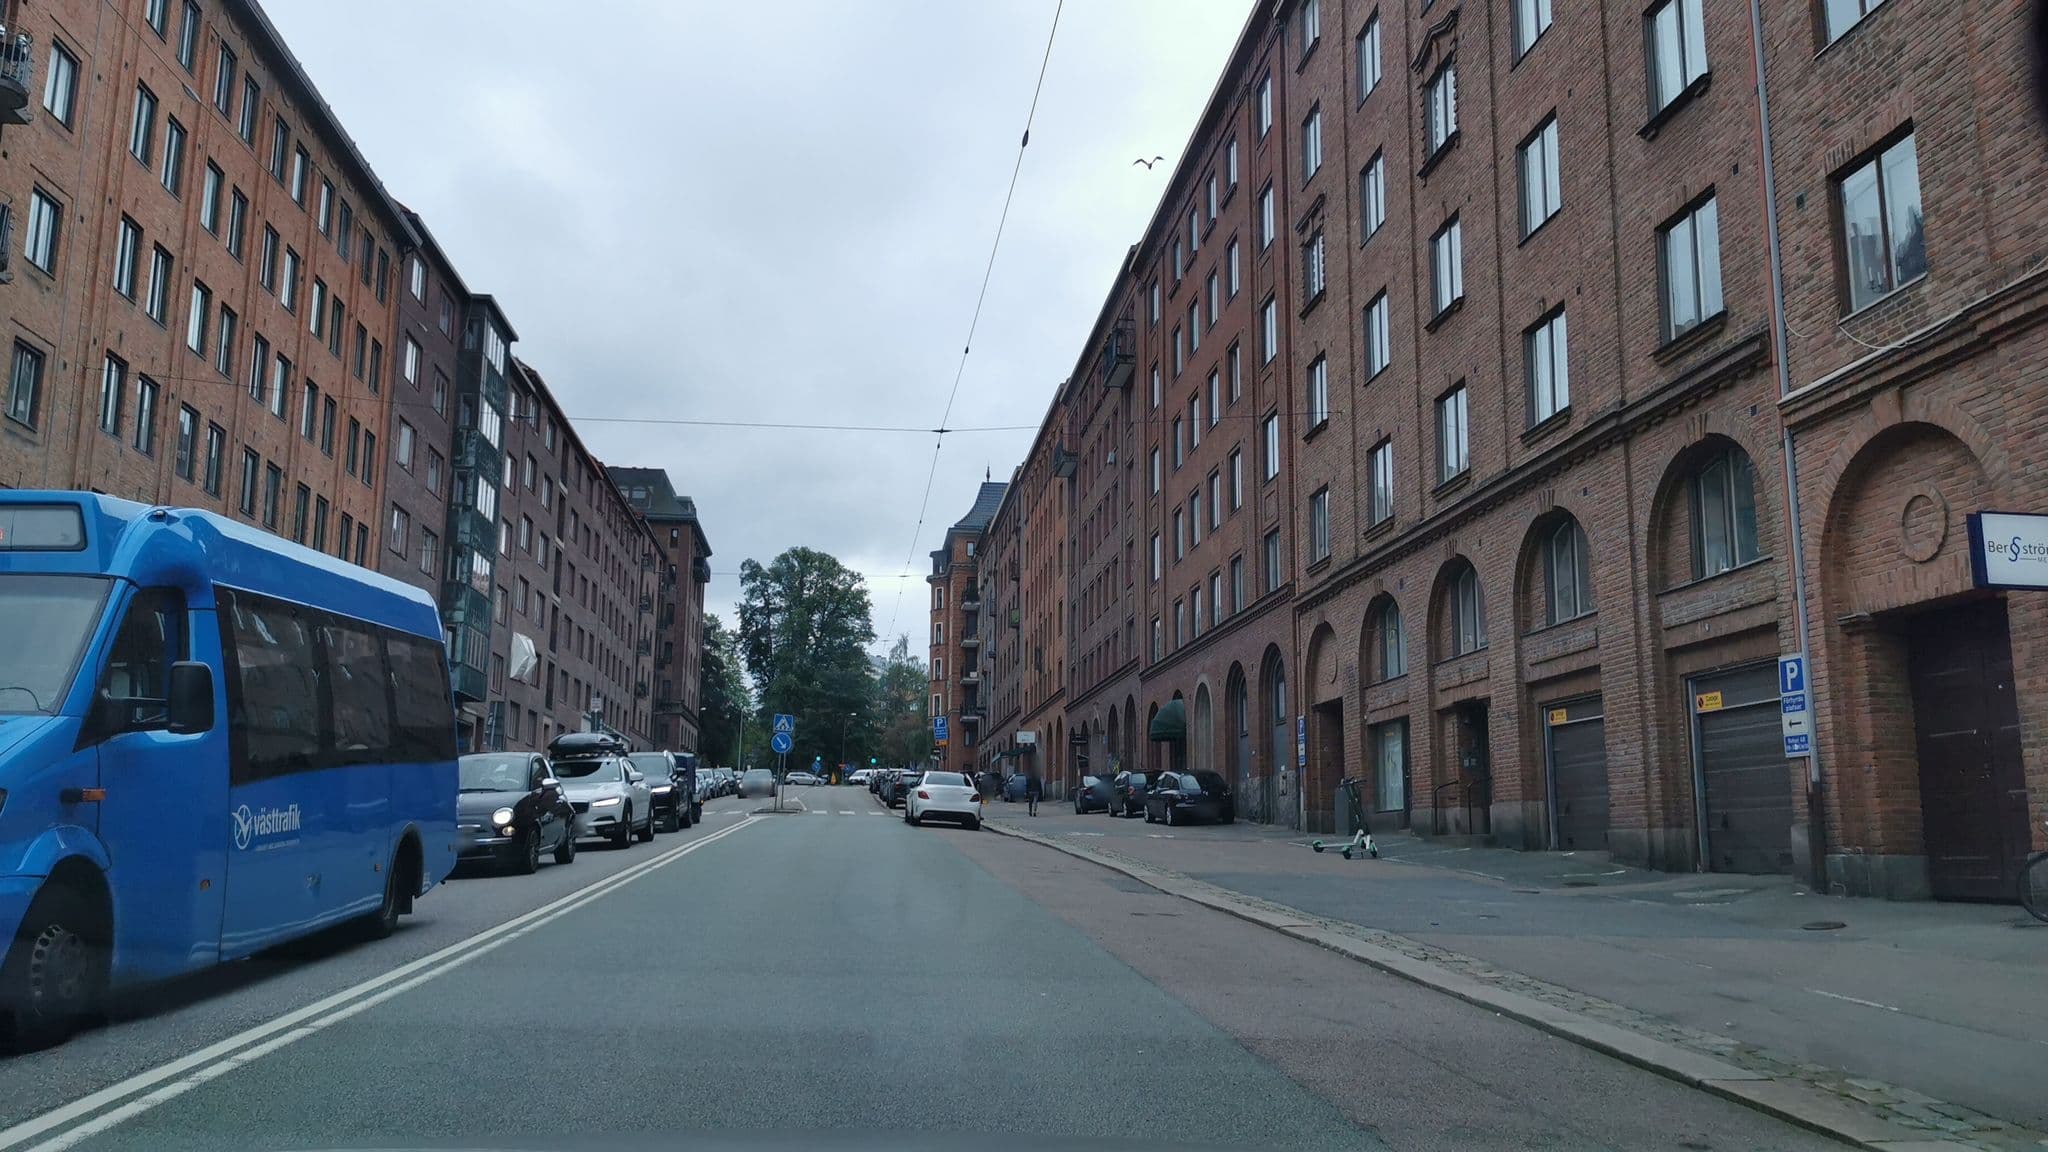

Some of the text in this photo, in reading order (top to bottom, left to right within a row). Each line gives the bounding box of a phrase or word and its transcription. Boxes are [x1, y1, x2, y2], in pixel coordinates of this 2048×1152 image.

[1786, 662, 1798, 690] P
[937, 719, 943, 728] P
[254, 804, 301, 835] västtrafik
